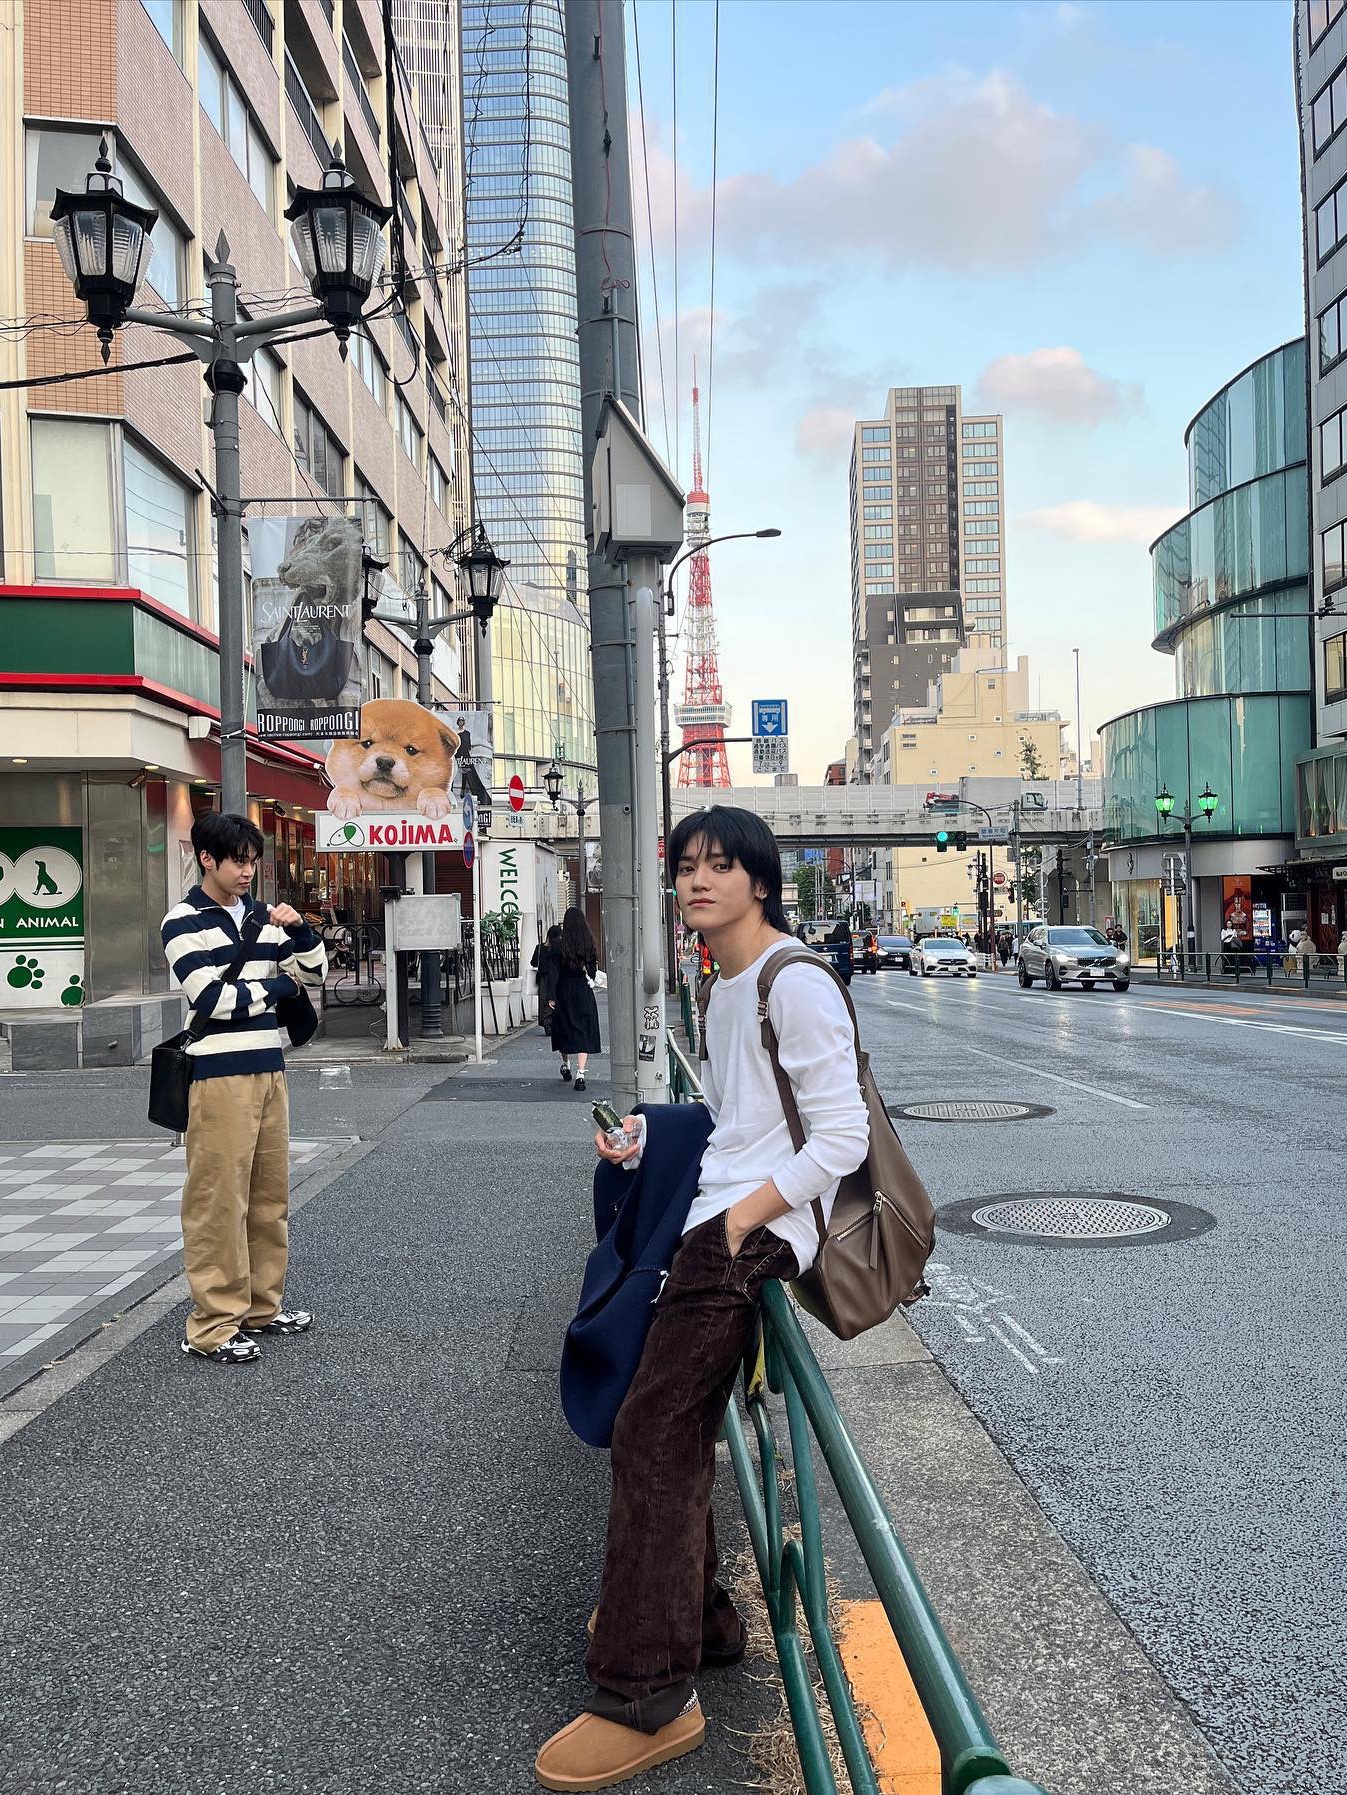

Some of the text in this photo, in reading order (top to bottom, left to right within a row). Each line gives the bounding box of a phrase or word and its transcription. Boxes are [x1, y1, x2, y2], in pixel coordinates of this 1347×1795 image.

[261, 601, 351, 623] SAINT LAURENT
[16, 916, 78, 928] ANIMAL
